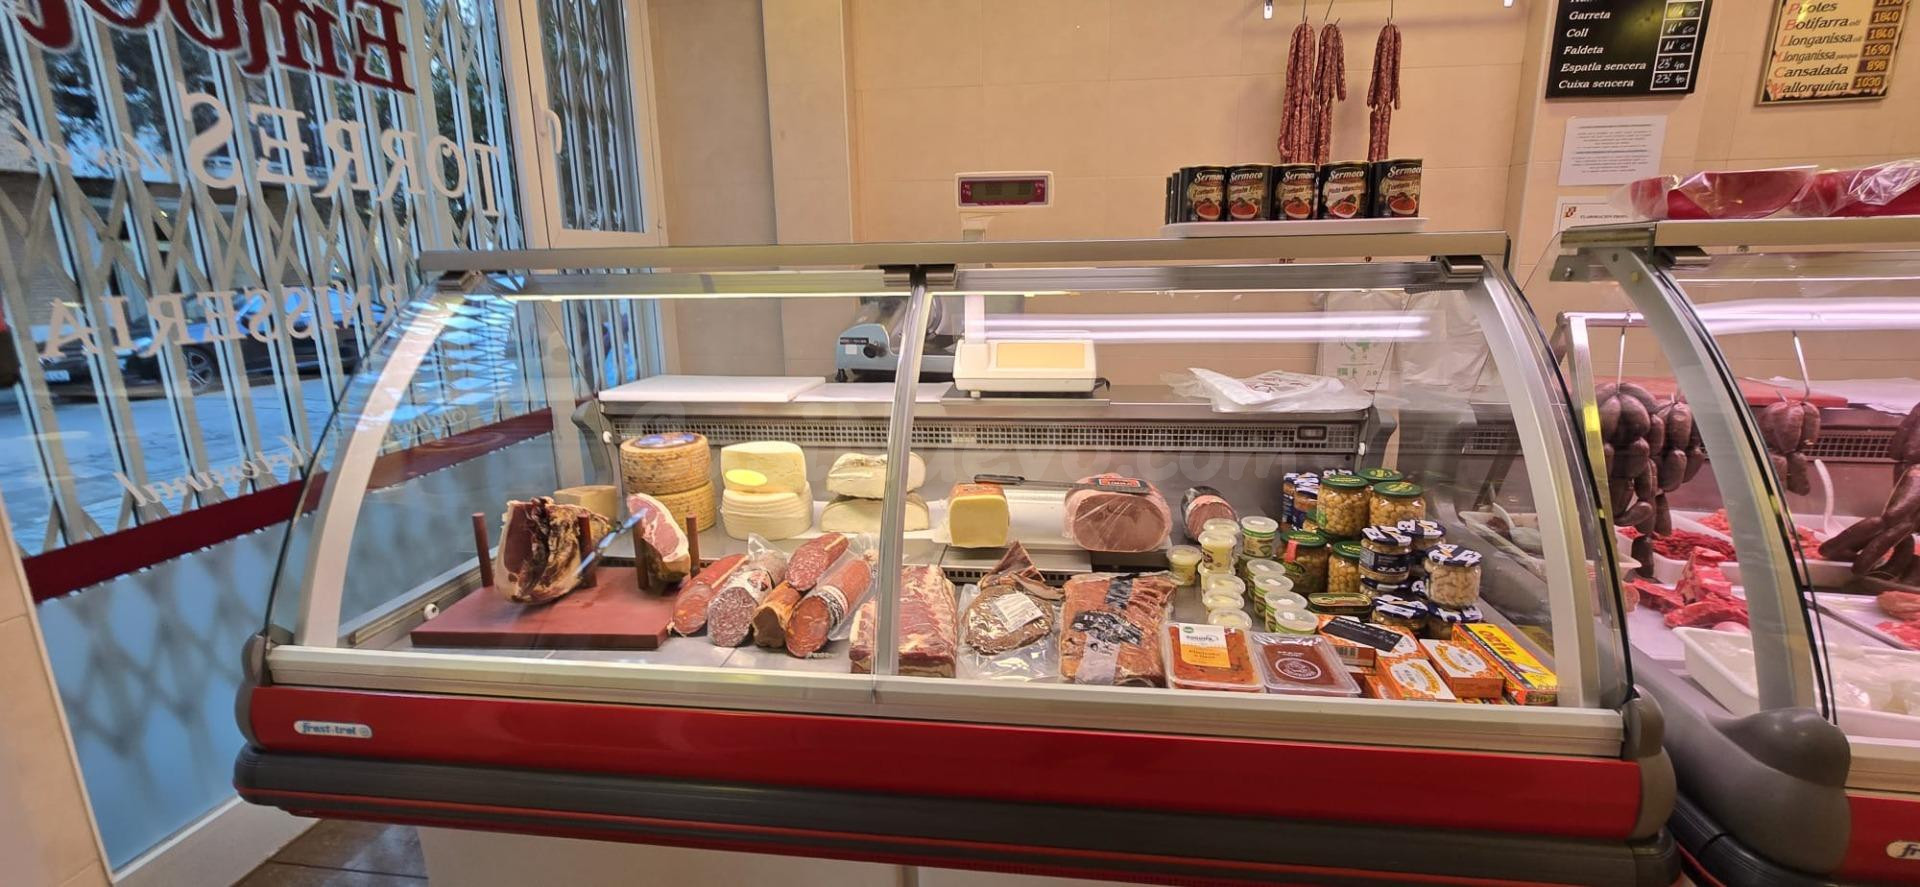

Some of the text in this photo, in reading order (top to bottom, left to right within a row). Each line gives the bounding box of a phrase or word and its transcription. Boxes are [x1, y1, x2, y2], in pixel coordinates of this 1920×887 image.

[1569, 11, 1611, 20] Garreta
[1784, 17, 1848, 30] Botifarra
[1566, 28, 1588, 37] Coll
[1780, 32, 1853, 47] Llonganissa
[1563, 45, 1604, 55] Faldeta
[1775, 49, 1835, 63] Llonganissa
[1604, 62, 1646, 71] sencera
[1774, 64, 1848, 78] Cansalada
[1558, 80, 1589, 89] Cuixa
[1592, 79, 1634, 88] sencera
[1771, 80, 1849, 97] Mallorquina
